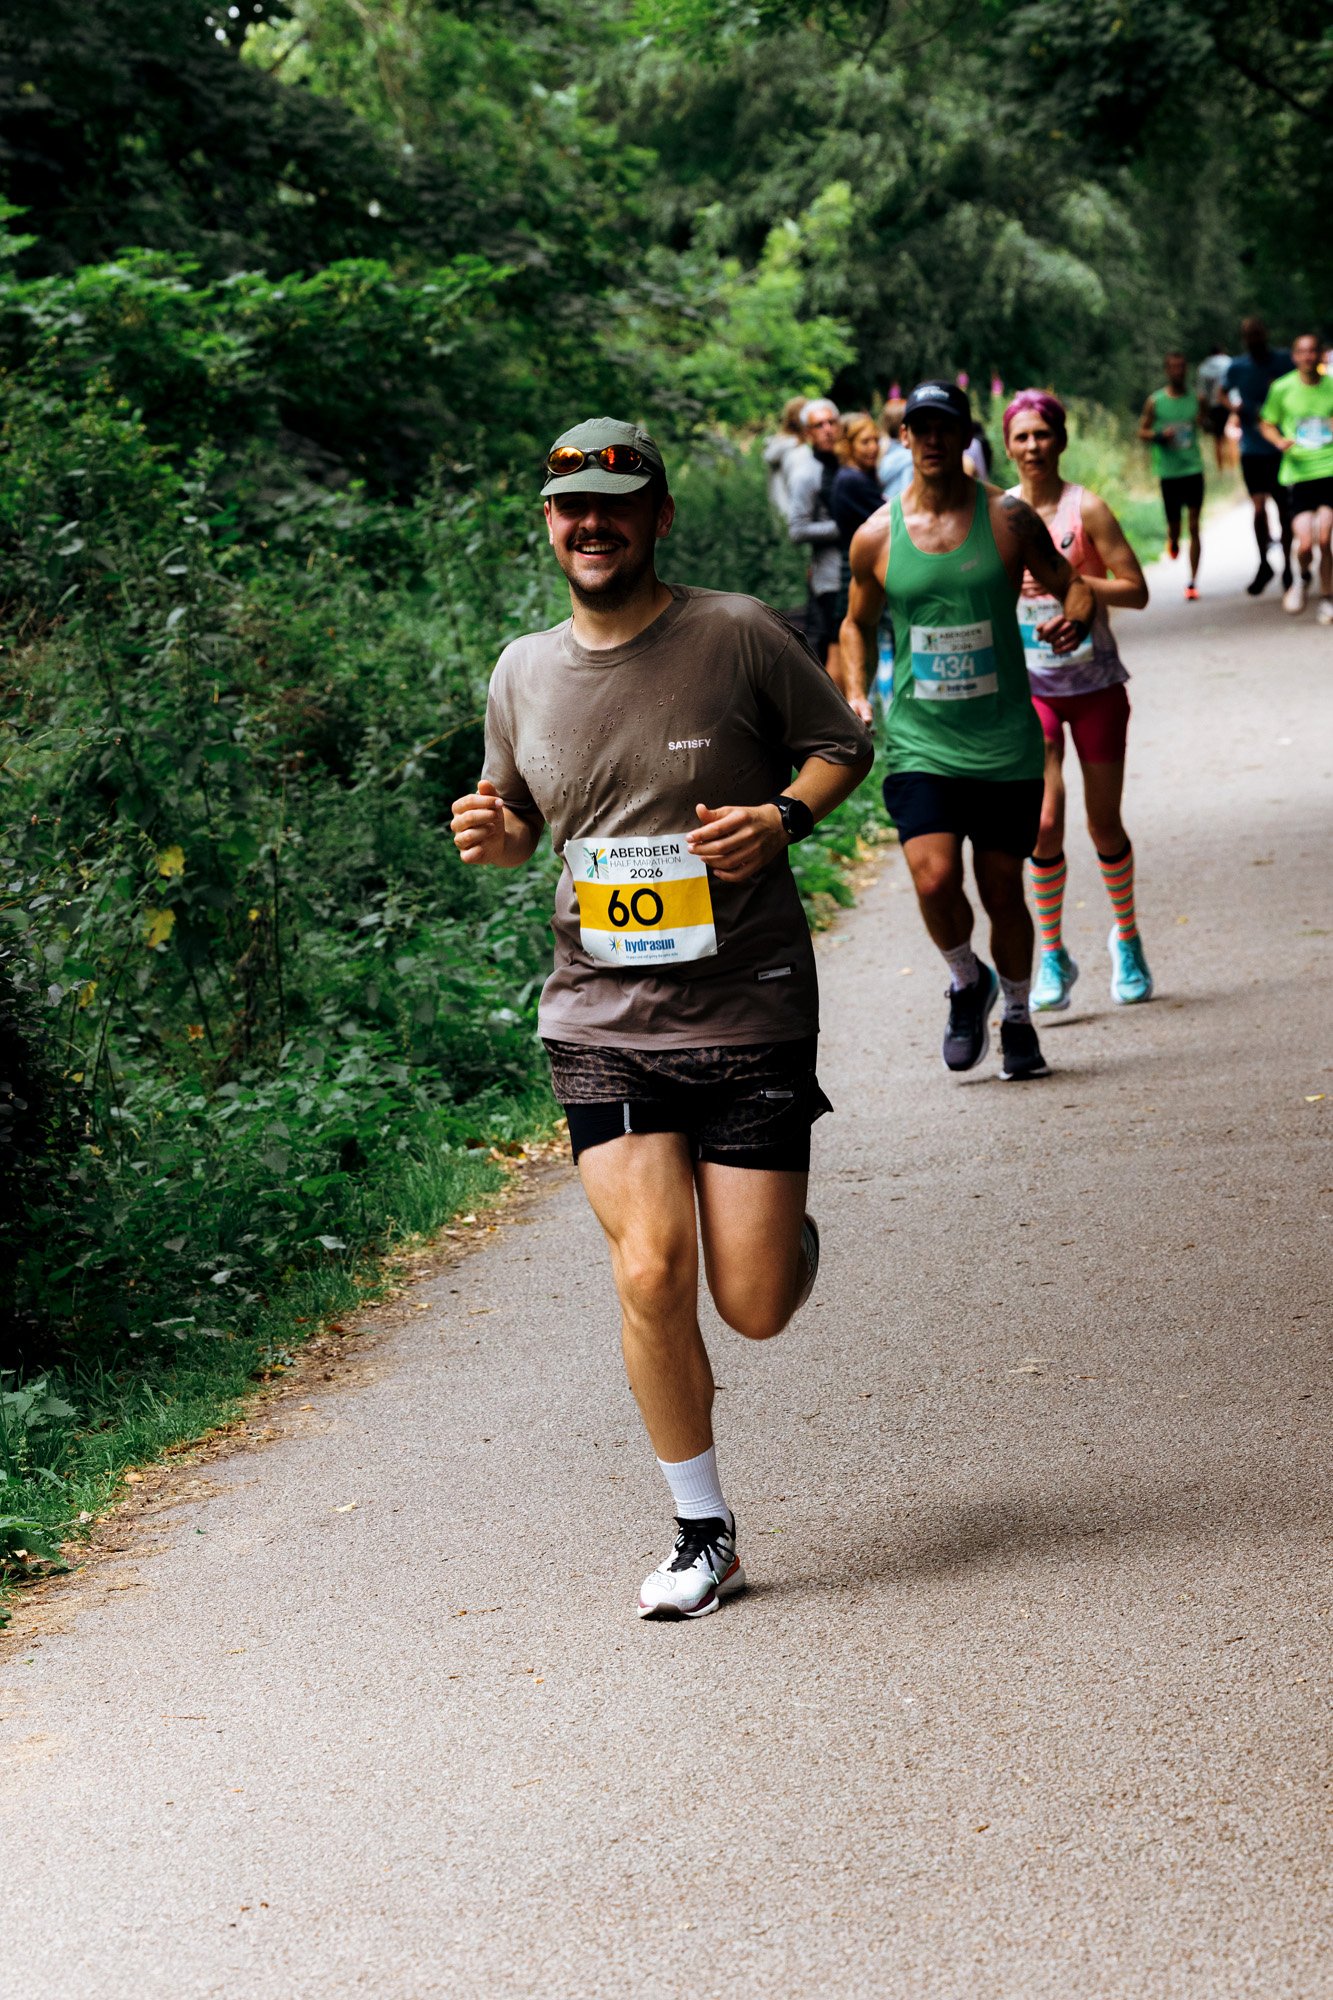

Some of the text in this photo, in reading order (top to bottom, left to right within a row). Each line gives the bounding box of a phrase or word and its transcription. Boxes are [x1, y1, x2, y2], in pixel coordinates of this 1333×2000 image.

[932, 655, 974, 678] 434
[668, 738, 711, 750] SATISFY
[610, 844, 680, 858] ABERDEEN
[610, 856, 682, 868] HALF MARATHON
[630, 867, 663, 879] 2026
[608, 888, 664, 927] 60
[624, 938, 675, 953] hydrasun
